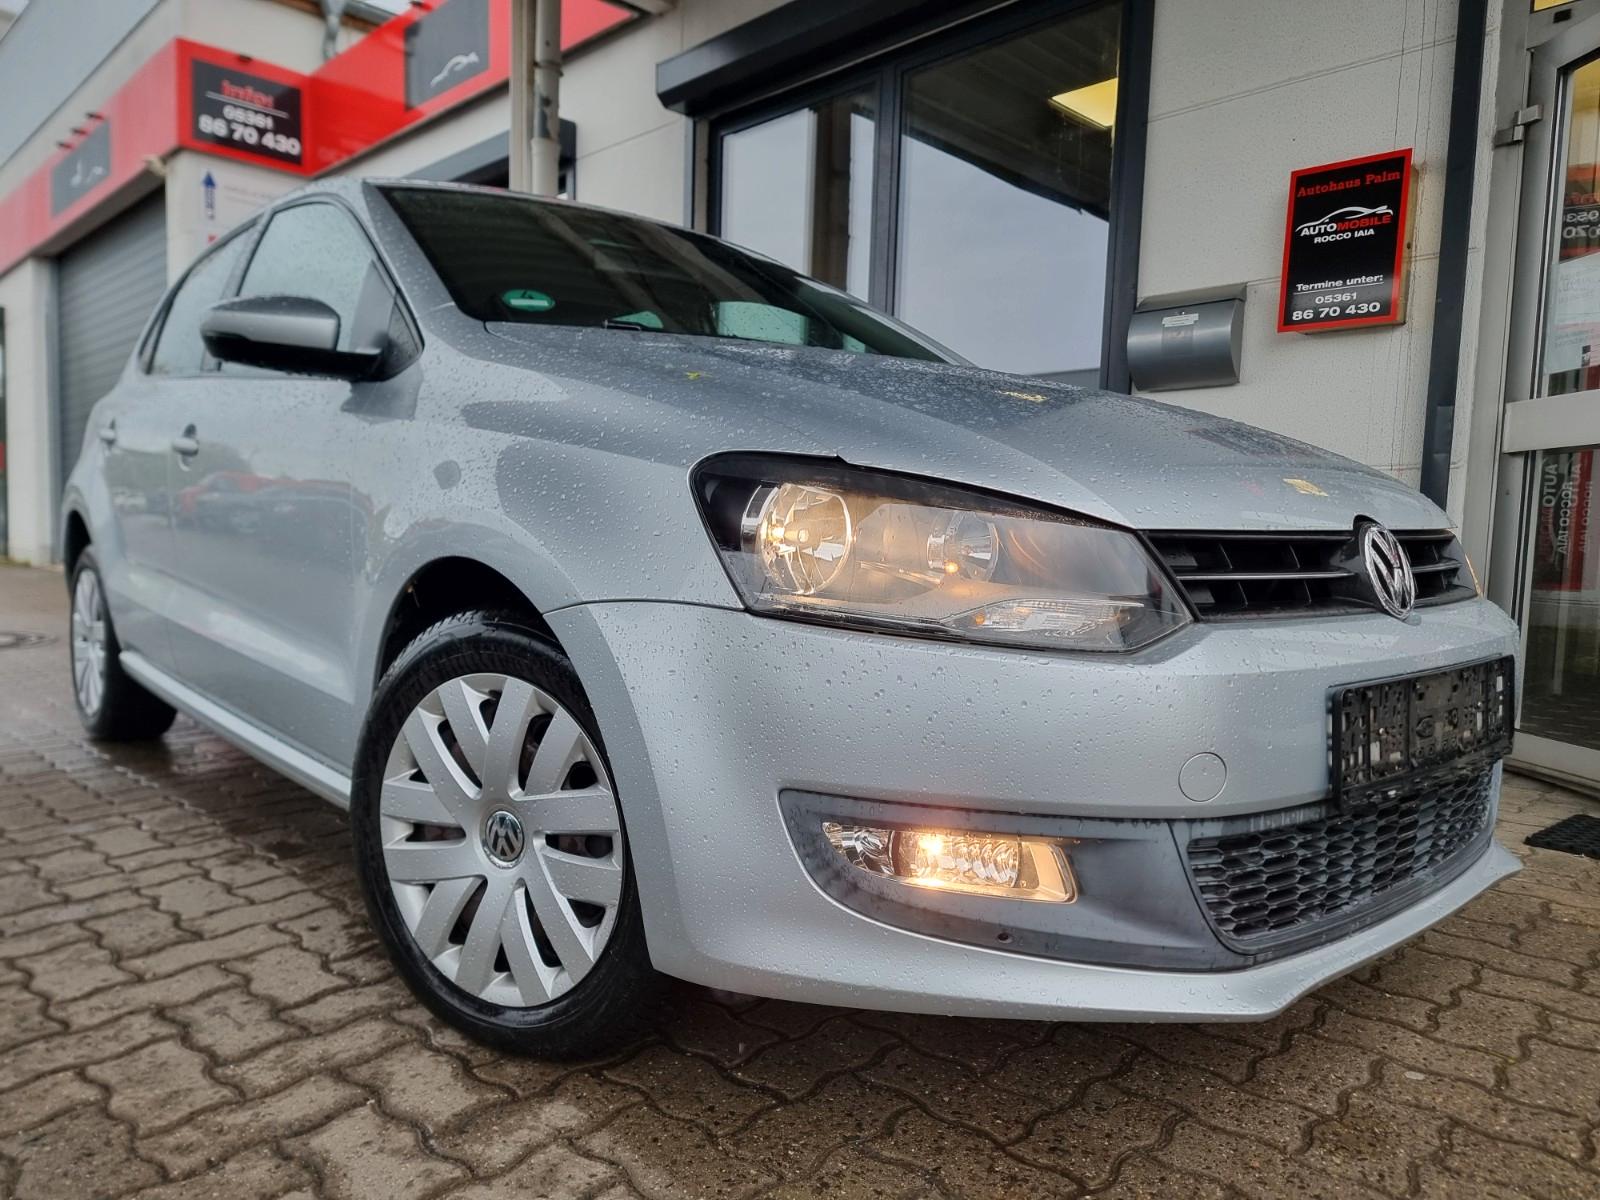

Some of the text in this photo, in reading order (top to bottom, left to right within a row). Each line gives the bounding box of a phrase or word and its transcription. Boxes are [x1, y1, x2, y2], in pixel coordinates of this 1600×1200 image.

[223, 104, 273, 130] 05361
[199, 114, 301, 156] 86 70 430
[1297, 171, 1400, 198] Autohaus Palm
[1300, 214, 1392, 237] AUTOMOBILE
[1313, 228, 1375, 244] ROCCO IAIA
[1296, 274, 1384, 292] Termine unter:
[1315, 292, 1357, 304] 05361
[1292, 301, 1381, 321] 86 70 430
